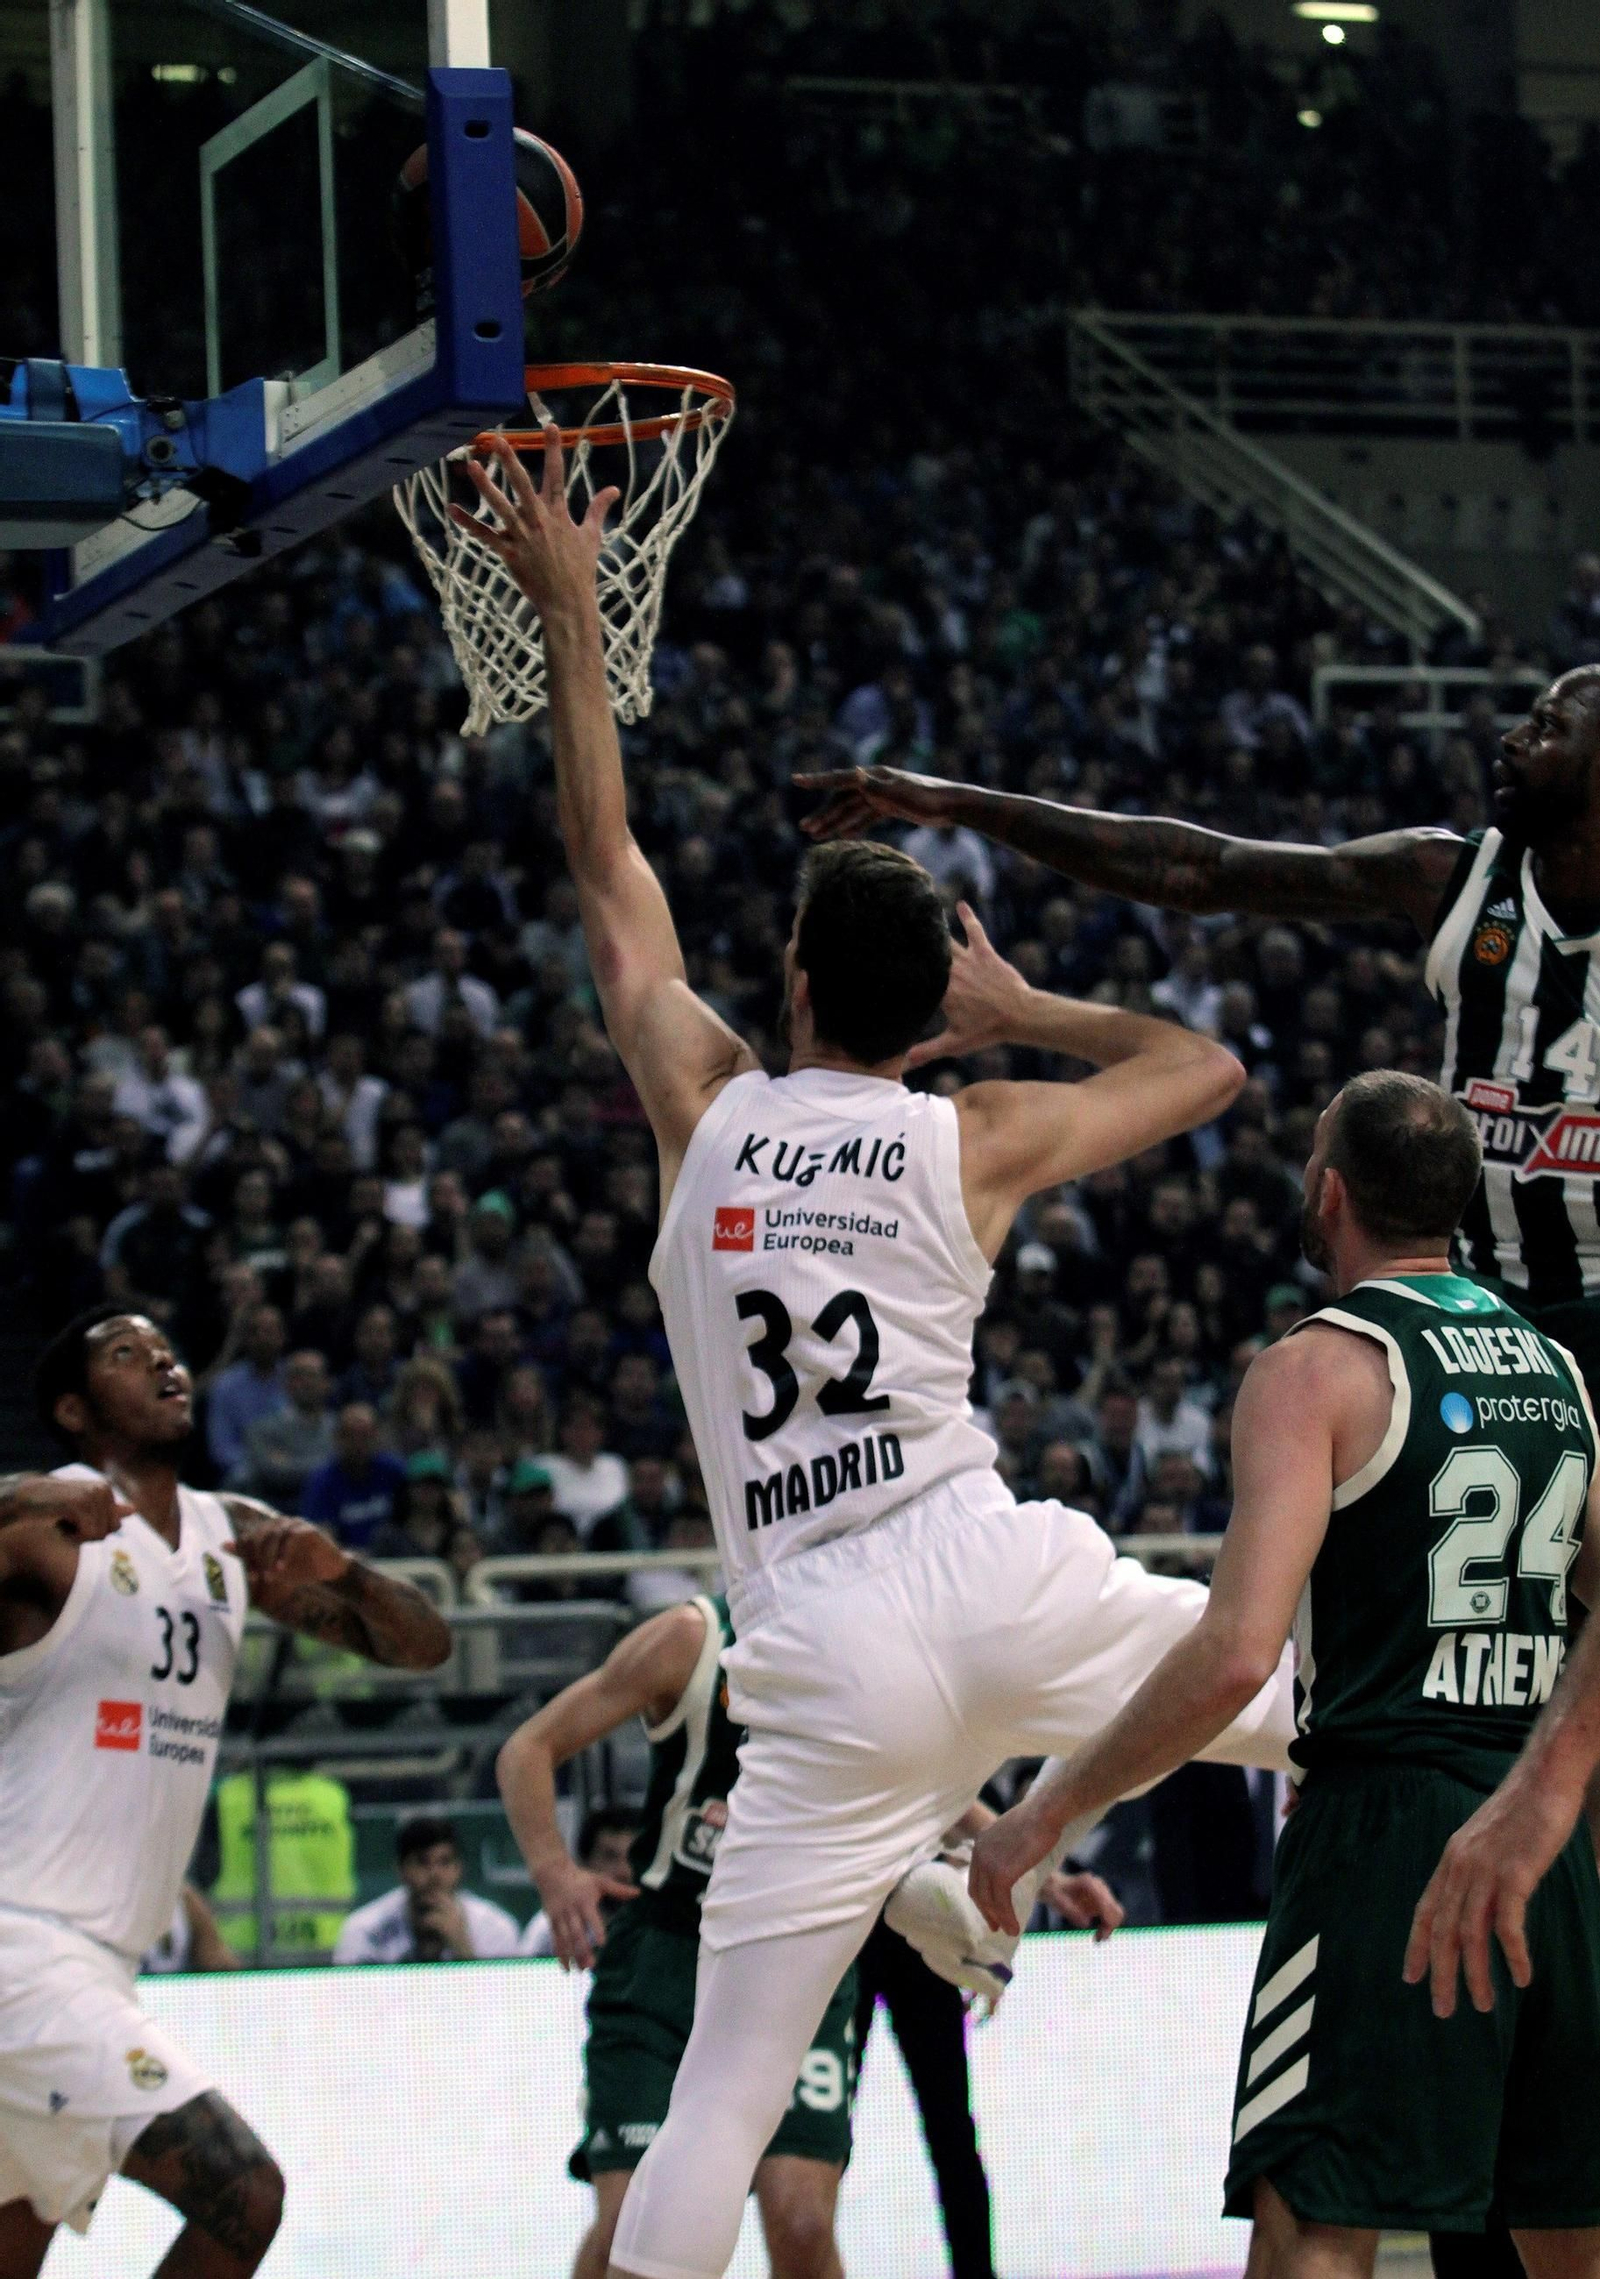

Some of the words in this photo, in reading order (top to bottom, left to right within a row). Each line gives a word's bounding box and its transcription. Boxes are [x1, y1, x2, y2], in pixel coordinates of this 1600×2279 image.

[1509, 1004, 1597, 1097] 14
[762, 1233, 854, 1256] Europea
[764, 1207, 899, 1239] Universidad
[735, 1289, 890, 1442] 32
[1420, 1326, 1559, 1378] LOJESKI
[1475, 1395, 1582, 1432] protergia
[744, 1433, 904, 1531] MADRID
[1427, 1444, 1588, 1628] 24
[151, 1606, 199, 1685] 33
[789, 2048, 843, 2111] 9
